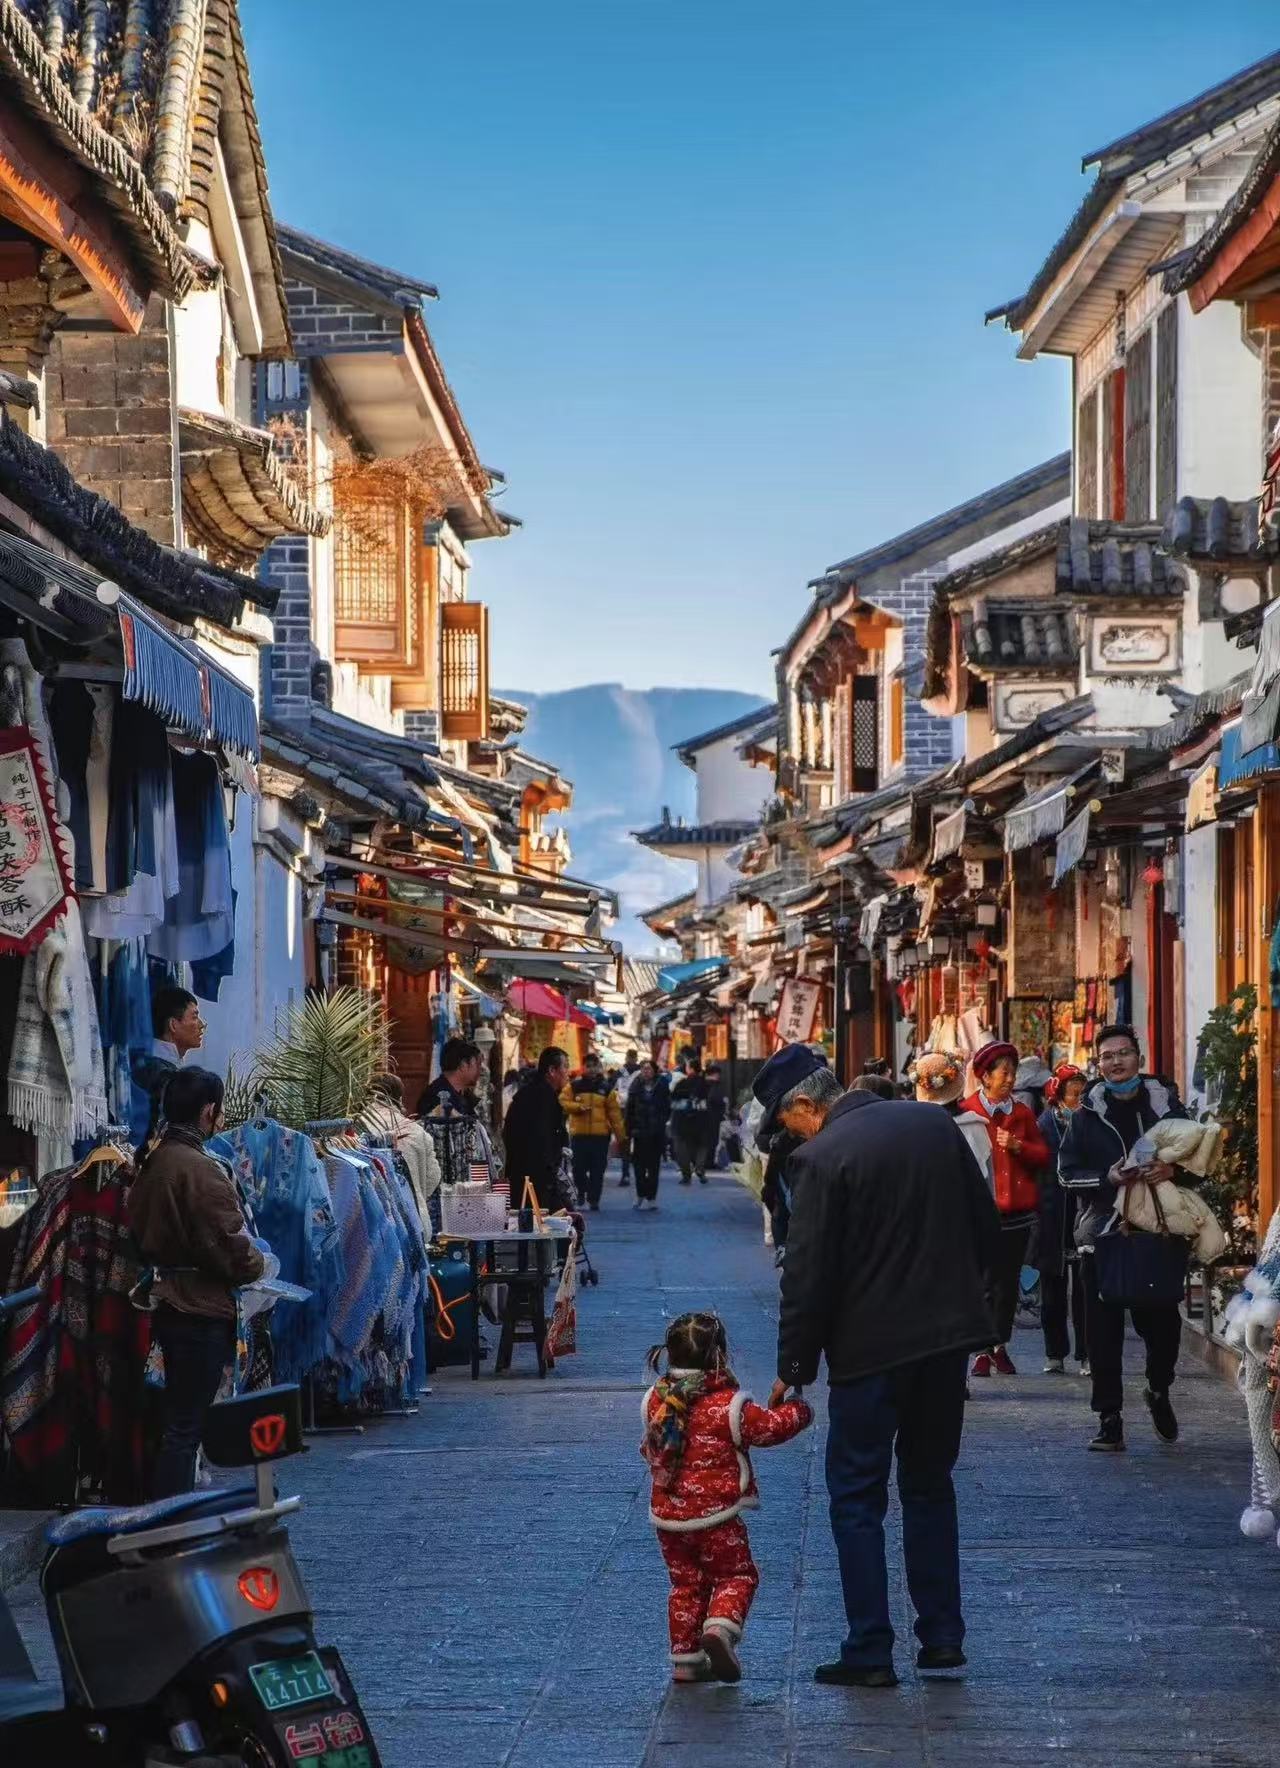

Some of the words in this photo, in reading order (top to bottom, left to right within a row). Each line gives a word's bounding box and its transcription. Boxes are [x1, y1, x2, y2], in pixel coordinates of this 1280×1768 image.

[12, 772, 41, 842] 纯手工制作
[265, 1673, 327, 1705] A4714
